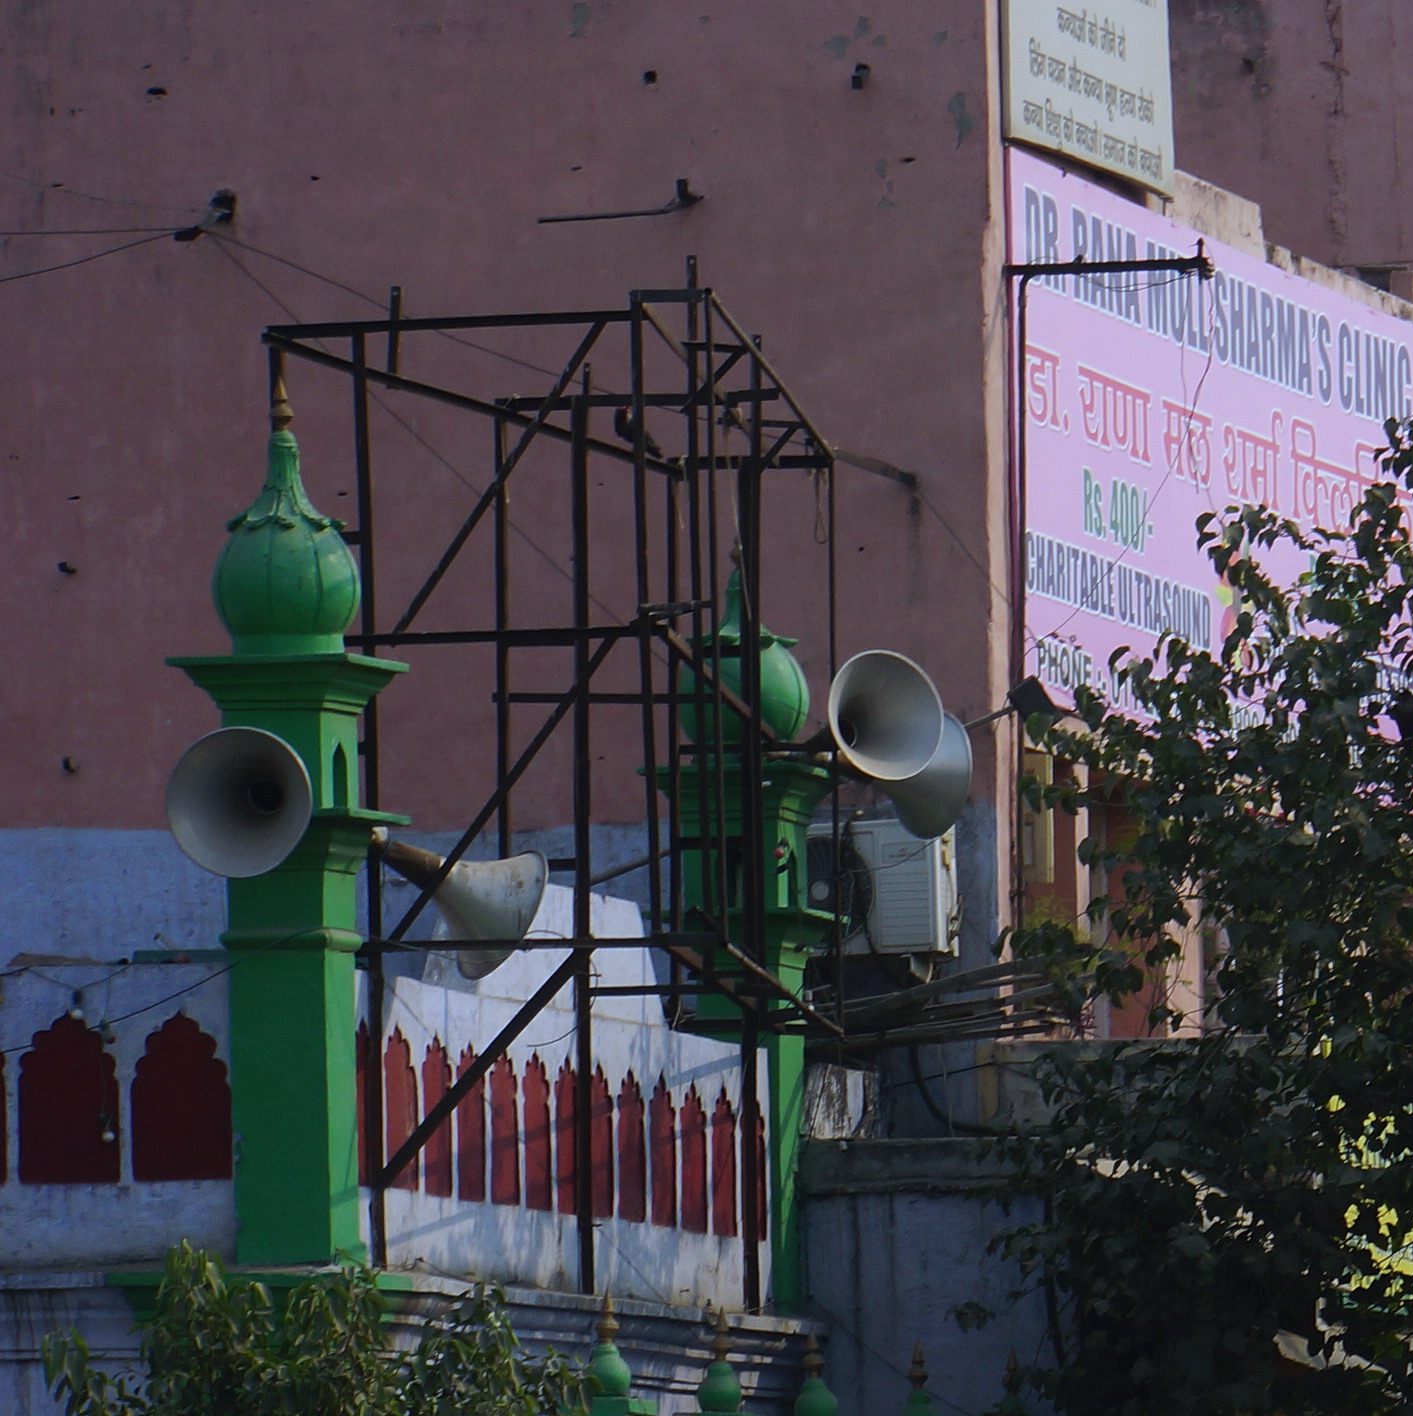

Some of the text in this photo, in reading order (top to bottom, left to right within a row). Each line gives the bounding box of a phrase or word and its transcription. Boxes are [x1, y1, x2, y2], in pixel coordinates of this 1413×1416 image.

[1072, 206, 1141, 326] RANA
[1213, 269, 1333, 404] SHARMA'S
[1338, 321, 1413, 425] CLINIC
[1083, 468, 1107, 540] Rs.
[1025, 532, 1116, 619] CHARITABLE
[1118, 564, 1212, 650] ULTRASOUND
[1038, 641, 1092, 691] PHONE
